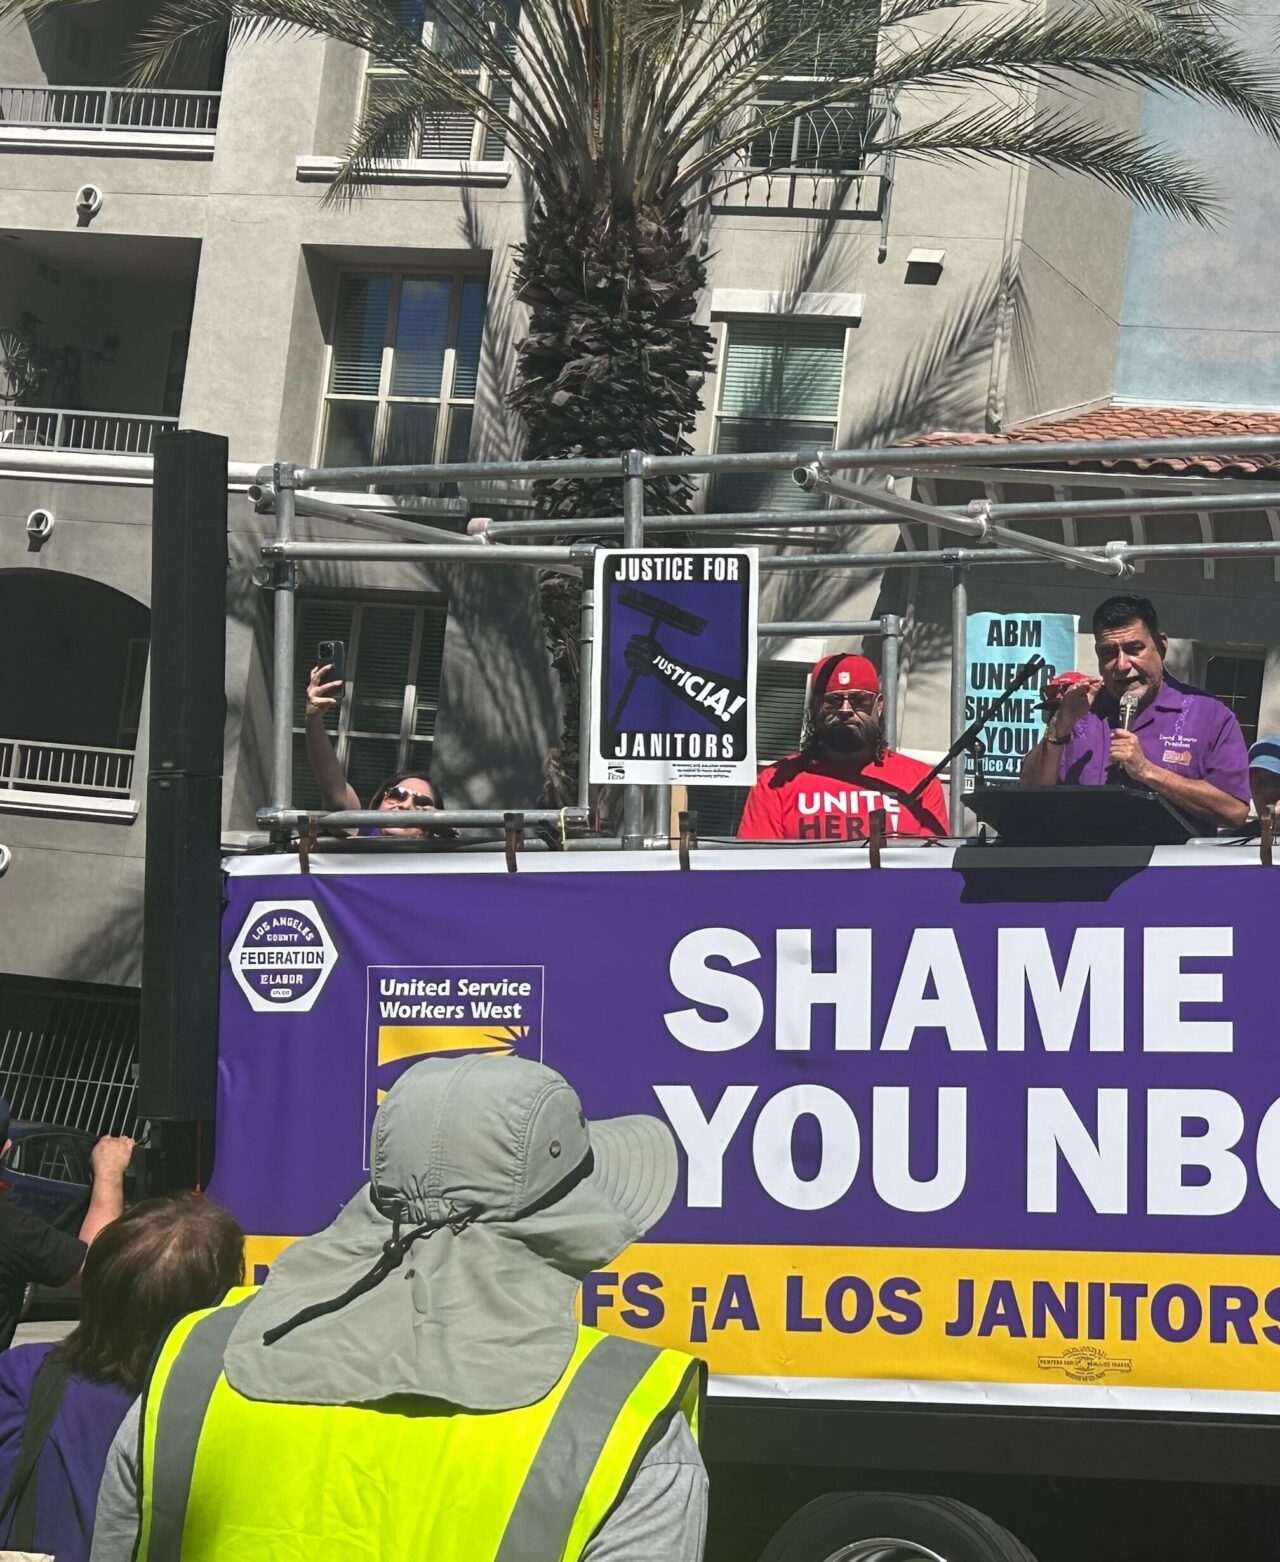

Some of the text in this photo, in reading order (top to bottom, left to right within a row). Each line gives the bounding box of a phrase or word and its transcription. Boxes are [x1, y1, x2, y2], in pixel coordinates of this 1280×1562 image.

[615, 557, 739, 581] JUSTICE FOR
[986, 619, 1042, 648] ABM
[652, 654, 748, 722] JUSTICIA!
[614, 732, 734, 759] JANITORS
[798, 790, 901, 815] UNITE
[251, 917, 315, 941] LOS ANGELES
[240, 951, 325, 965] FEDERATION
[379, 978, 532, 997] United Service
[663, 926, 1234, 1053] SHAME
[379, 1001, 522, 1020] Workers West
[653, 1084, 968, 1213] YOU
[786, 1275, 924, 1335] LOS
